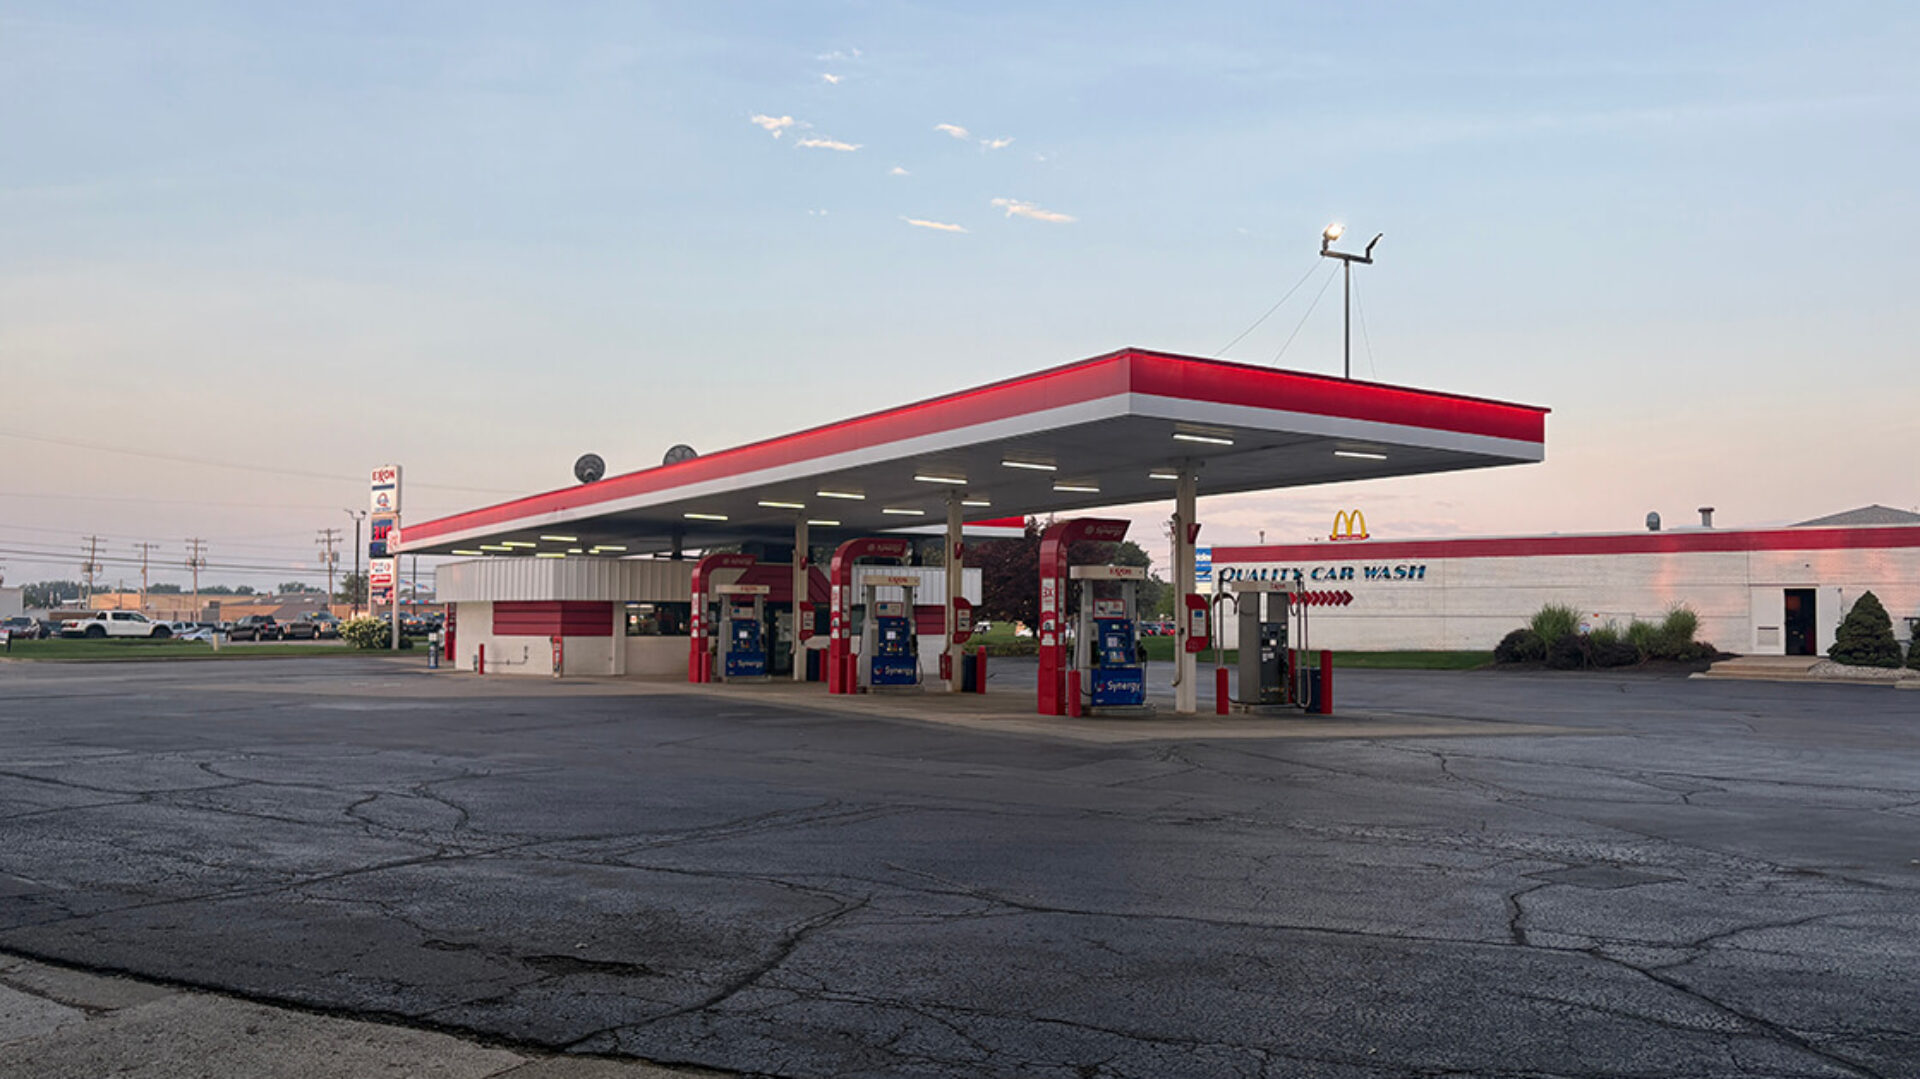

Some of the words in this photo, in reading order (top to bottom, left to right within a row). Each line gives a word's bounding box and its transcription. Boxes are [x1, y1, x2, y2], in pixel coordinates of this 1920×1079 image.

[1221, 567, 1304, 582] QUALITY
[1311, 566, 1354, 581] CAR
[1364, 565, 1427, 579] WASH
[1107, 680, 1140, 693] Synergy
